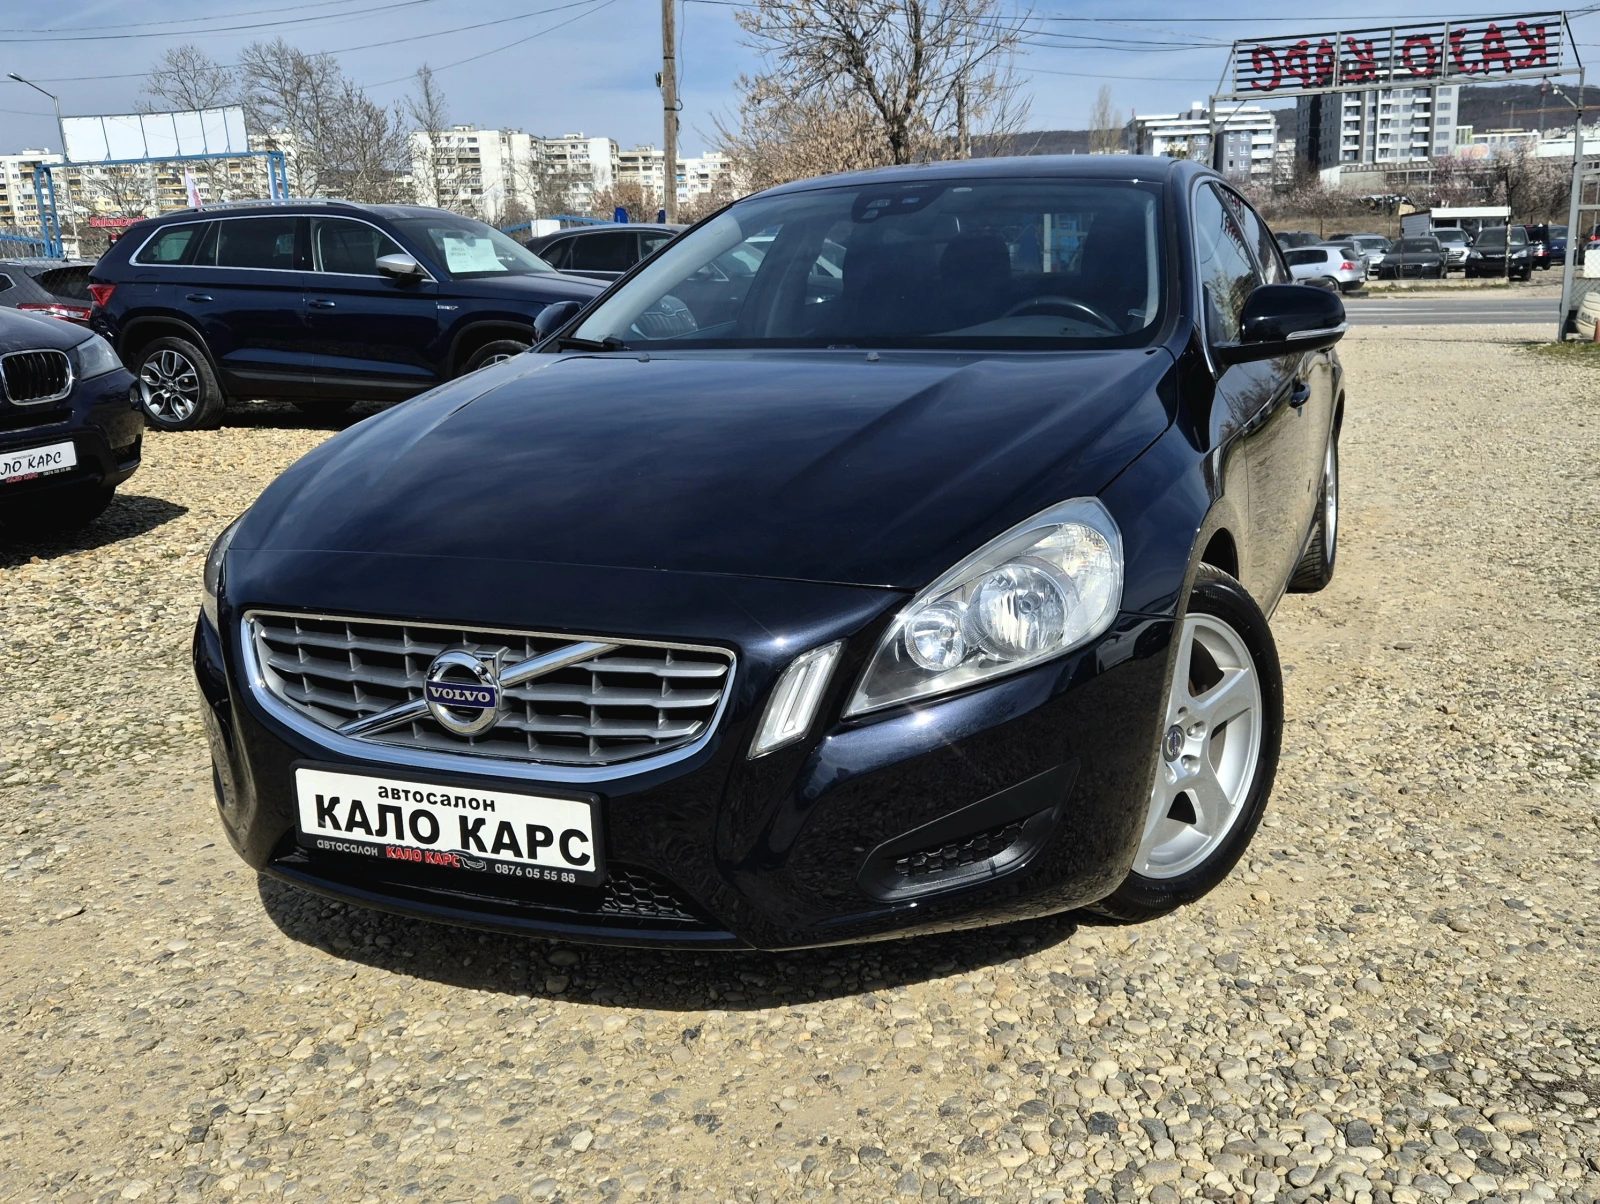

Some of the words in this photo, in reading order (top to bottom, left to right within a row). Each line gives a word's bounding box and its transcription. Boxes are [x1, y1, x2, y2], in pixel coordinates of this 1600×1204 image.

[0, 460, 22, 476] ЛО
[28, 451, 62, 469] КАРС
[429, 686, 491, 703] VOLVO
[378, 785, 496, 812] автосалон
[315, 794, 440, 845] КАЛО
[459, 815, 591, 867] КАРС
[316, 839, 379, 857] автосалон
[386, 845, 423, 862] КАЛО
[425, 850, 461, 868] КАРС
[494, 863, 523, 877] 0876
[525, 867, 541, 879] 05
[543, 870, 558, 881] 55
[560, 873, 576, 884] 88
